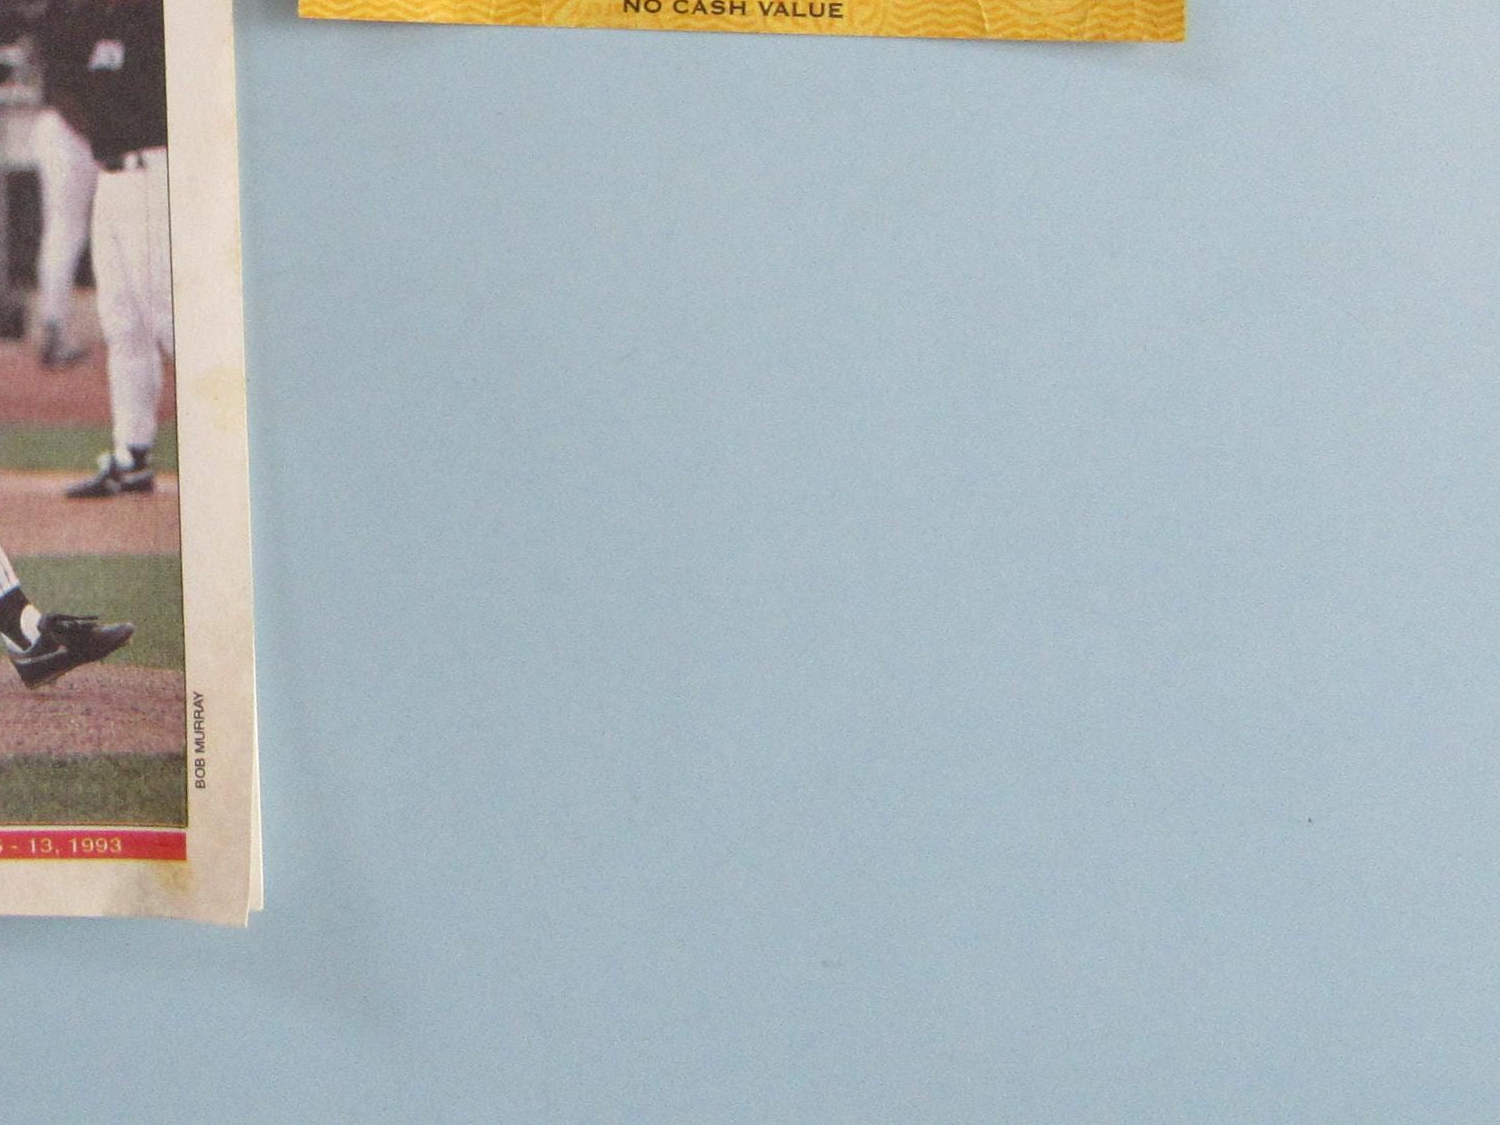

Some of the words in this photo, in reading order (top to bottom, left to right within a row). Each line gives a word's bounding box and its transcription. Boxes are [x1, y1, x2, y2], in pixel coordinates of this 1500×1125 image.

[759, 1, 843, 19] VALUE
[193, 691, 205, 753] MURRAY
[195, 758, 205, 789] BOB
[28, 837, 60, 857] 13,
[69, 836, 123, 854] 1993
